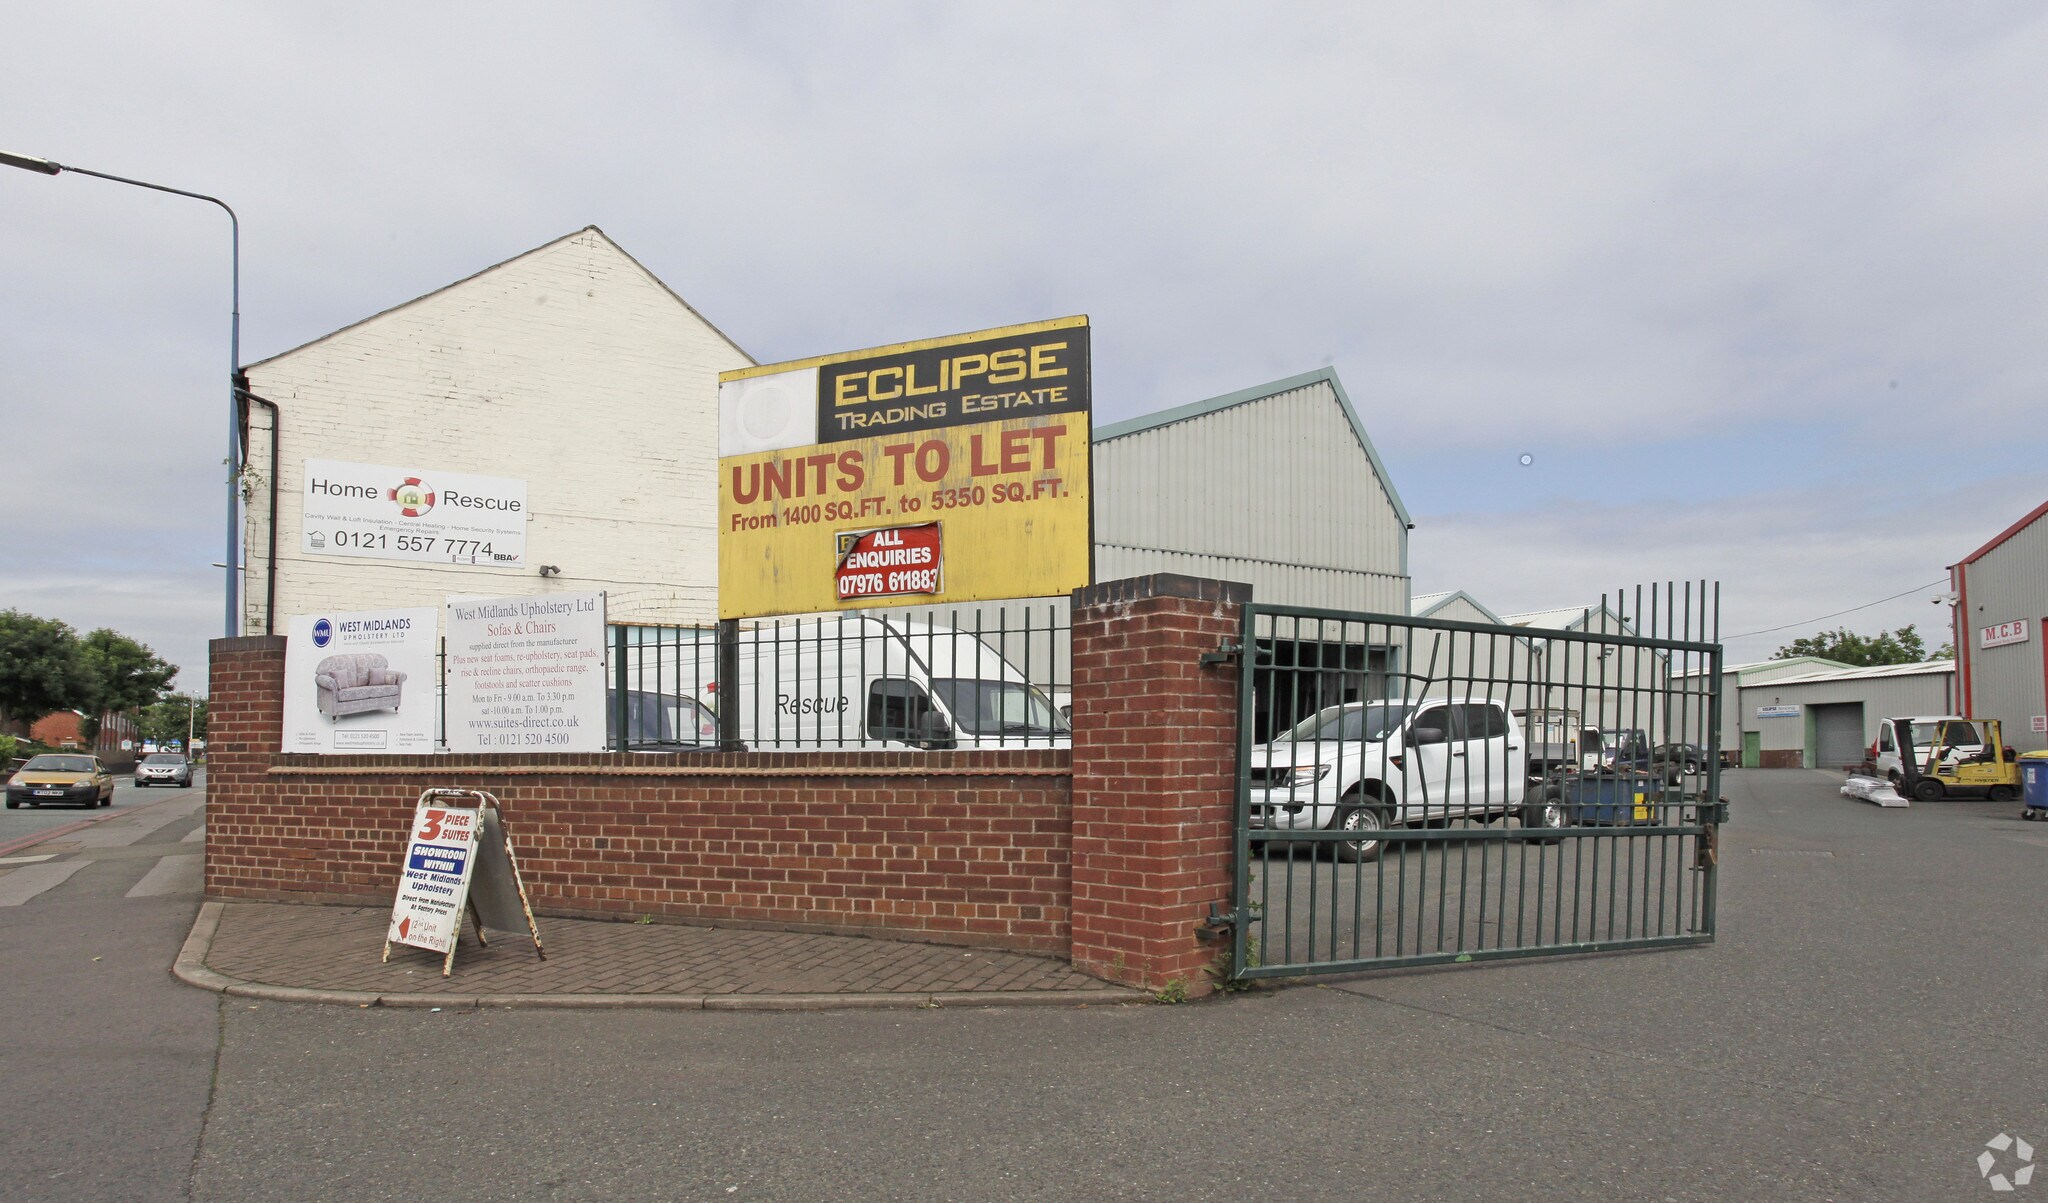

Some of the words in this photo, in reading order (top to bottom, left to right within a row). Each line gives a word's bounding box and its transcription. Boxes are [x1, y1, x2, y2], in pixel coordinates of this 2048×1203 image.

[835, 342, 1068, 407] ECLIPSE
[835, 401, 947, 430] TRADING
[961, 386, 1068, 414] ESTATE
[732, 450, 865, 505] UNITS
[884, 439, 950, 486] TO
[970, 425, 1067, 477] LET
[311, 478, 378, 499] Home
[443, 490, 521, 512] Rescue
[731, 513, 777, 532] From
[783, 504, 821, 526] 1400
[825, 496, 892, 521] SQ.FT.
[900, 494, 921, 513] to
[931, 485, 985, 510] 5350
[992, 478, 1068, 504] SQ.FT.
[304, 512, 325, 521] Cavity
[363, 517, 393, 525] Insulation
[398, 519, 421, 528] Central
[422, 522, 446, 530] Heating
[470, 526, 494, 534] Security
[496, 528, 521, 536] Systems
[379, 525, 414, 534] Emergency
[335, 530, 387, 549] 0121
[397, 535, 436, 553] 557
[443, 538, 493, 557] 7774
[873, 529, 904, 547] ALL
[493, 553, 513, 561] BBA
[846, 546, 932, 569] ENQUIRIES
[840, 573, 884, 594] 07976
[455, 608, 476, 620] West
[478, 603, 518, 619] Midlands
[520, 600, 573, 619] Upholstery
[576, 598, 594, 612] Ltd
[339, 621, 361, 632] WEST
[363, 618, 411, 631] MIDLANDS
[487, 622, 512, 637] Sofas
[514, 621, 523, 635] &
[525, 619, 557, 635] Chairs
[1985, 621, 2022, 640] M.C.B
[343, 632, 388, 640] UPHOLSTERY
[469, 641, 492, 652] supplied
[493, 641, 510, 649] direct
[510, 639, 525, 648] from
[526, 639, 536, 647] the
[536, 637, 578, 646] manufacturer
[453, 654, 466, 664] Plus
[467, 656, 479, 664] new
[480, 654, 493, 663] seat
[494, 653, 515, 662] foams,
[517, 650, 562, 663] re-upholstery,
[564, 650, 578, 659] seat
[580, 648, 599, 661] pads,
[461, 668, 472, 677] rise
[473, 667, 479, 676] &
[480, 666, 501, 676] recline
[502, 665, 524, 675] chairs,
[525, 663, 565, 676] orthopaedic
[566, 664, 589, 675] range,
[474, 679, 504, 690] footstools
[505, 679, 518, 689] and
[519, 679, 541, 688] scatter
[542, 677, 573, 687] cushions
[472, 694, 486, 703] Mon
[486, 695, 493, 703] to
[493, 693, 502, 702] Fri
[507, 693, 521, 702] 9.00
[537, 692, 545, 701] To
[546, 691, 561, 701] 3.30
[481, 707, 490, 715] sat
[524, 704, 533, 714] To
[535, 704, 549, 714] 1.00
[775, 694, 849, 716] Rescue
[468, 715, 579, 729] www.suites-direct.co.uk
[477, 733, 491, 745] Tel
[499, 733, 521, 745] 0121
[524, 733, 542, 745] 520
[545, 733, 570, 745] 4500
[418, 810, 446, 840] 3
[445, 814, 470, 826] PIECE
[441, 829, 470, 841] SUITES
[413, 845, 466, 861] SHOWROOM
[423, 859, 455, 872] WITHIN
[406, 870, 428, 880] West
[430, 873, 462, 886] Midlands
[411, 881, 454, 896] Upholstery
[401, 894, 418, 902] Direct
[417, 904, 434, 914] Factory
[434, 907, 448, 915] Prices
[423, 921, 437, 932] Unit
[408, 933, 417, 941] on
[417, 933, 428, 943] the
